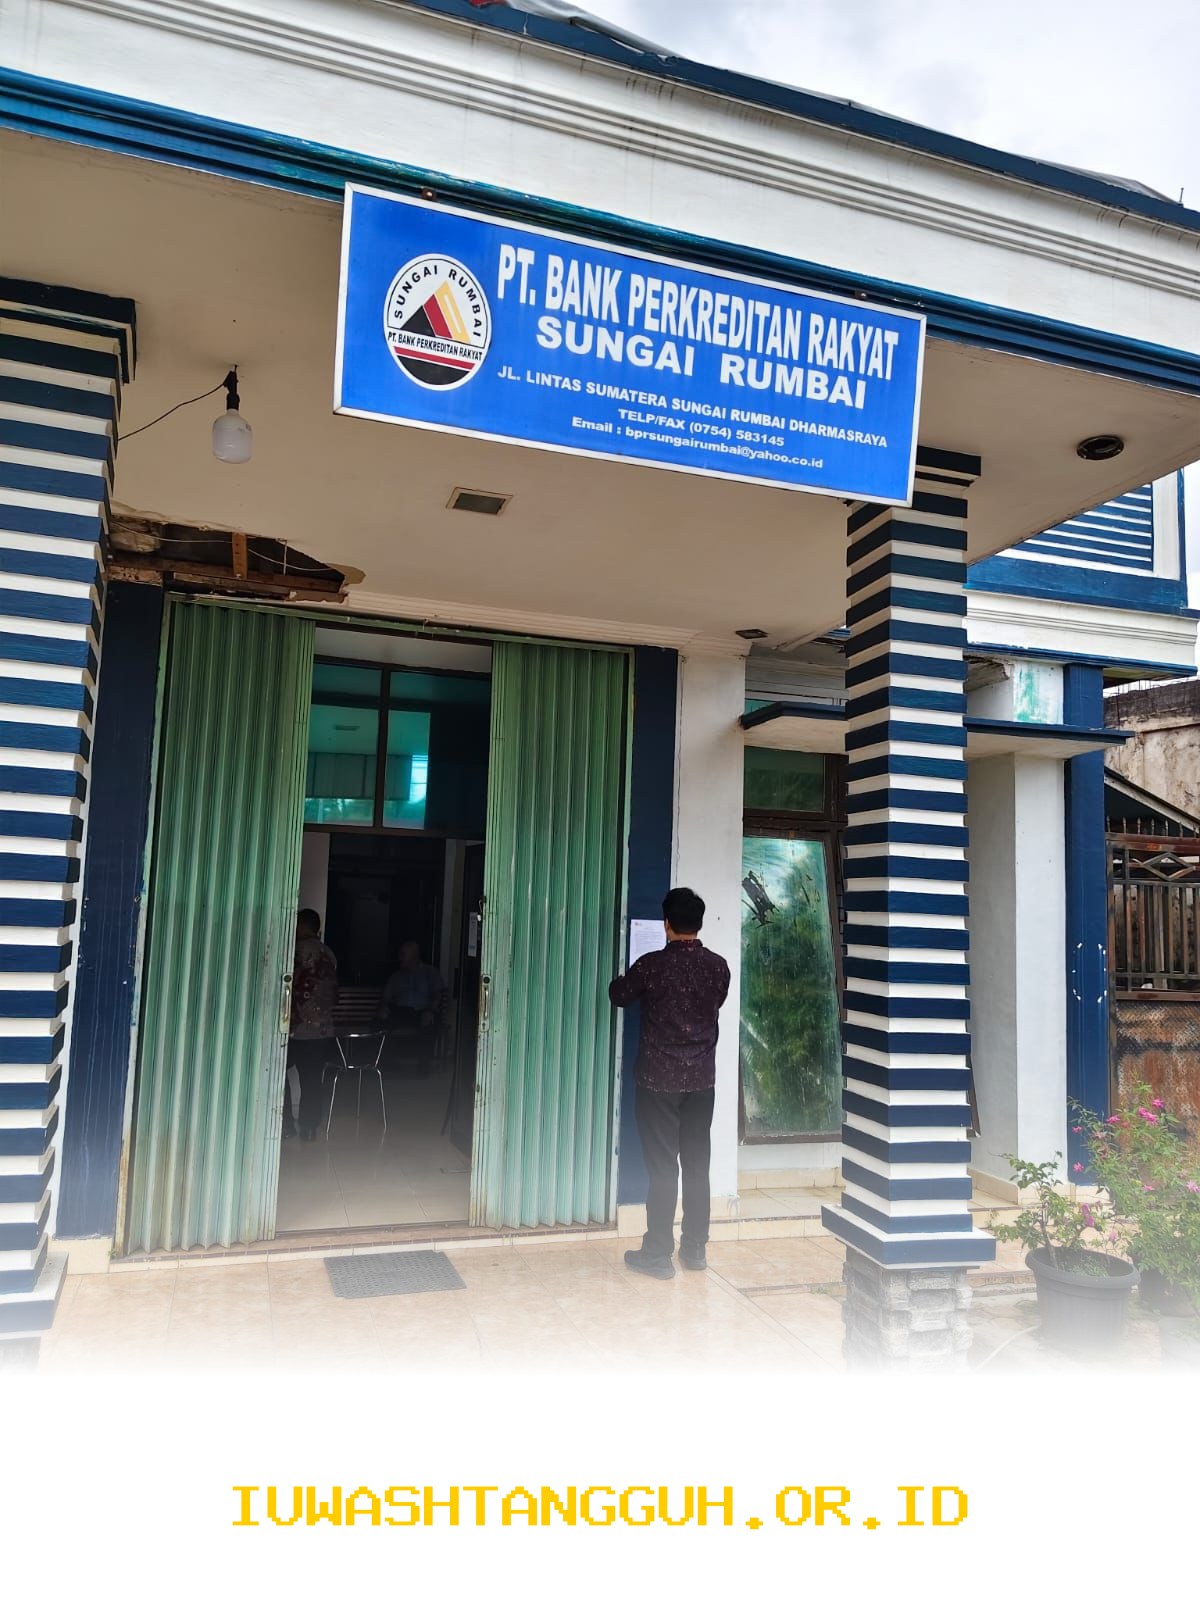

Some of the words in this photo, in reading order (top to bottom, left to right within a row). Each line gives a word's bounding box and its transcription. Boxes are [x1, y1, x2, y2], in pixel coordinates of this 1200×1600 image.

[394, 265, 438, 319] SUNGAI
[448, 268, 482, 337] RUMBAI
[497, 243, 535, 306] PT.
[546, 254, 622, 322] BANK
[628, 275, 802, 360] PERKREDITAN
[807, 313, 899, 379] RAKYAT
[387, 331, 397, 342] PT.
[398, 334, 415, 346] BANK
[416, 337, 459, 356] PERKREDITAN
[460, 347, 483, 361] RAKYAT
[537, 316, 694, 377] SUNGAI
[720, 353, 866, 409] RUMBAI
[497, 366, 521, 381] JL.
[526, 370, 581, 392] LINTAS
[585, 381, 667, 408] SUMATERA
[671, 397, 727, 418] SUNGAI
[730, 408, 786, 429] RUMBAI
[789, 420, 888, 448] DHARMASRAYA
[571, 417, 613, 434] Email
[625, 427, 823, 469] bprsungairumbai@yahoo.co.id
[618, 408, 685, 430] TELP/FAX
[688, 421, 732, 440] (0754)
[735, 430, 785, 447] 583145
